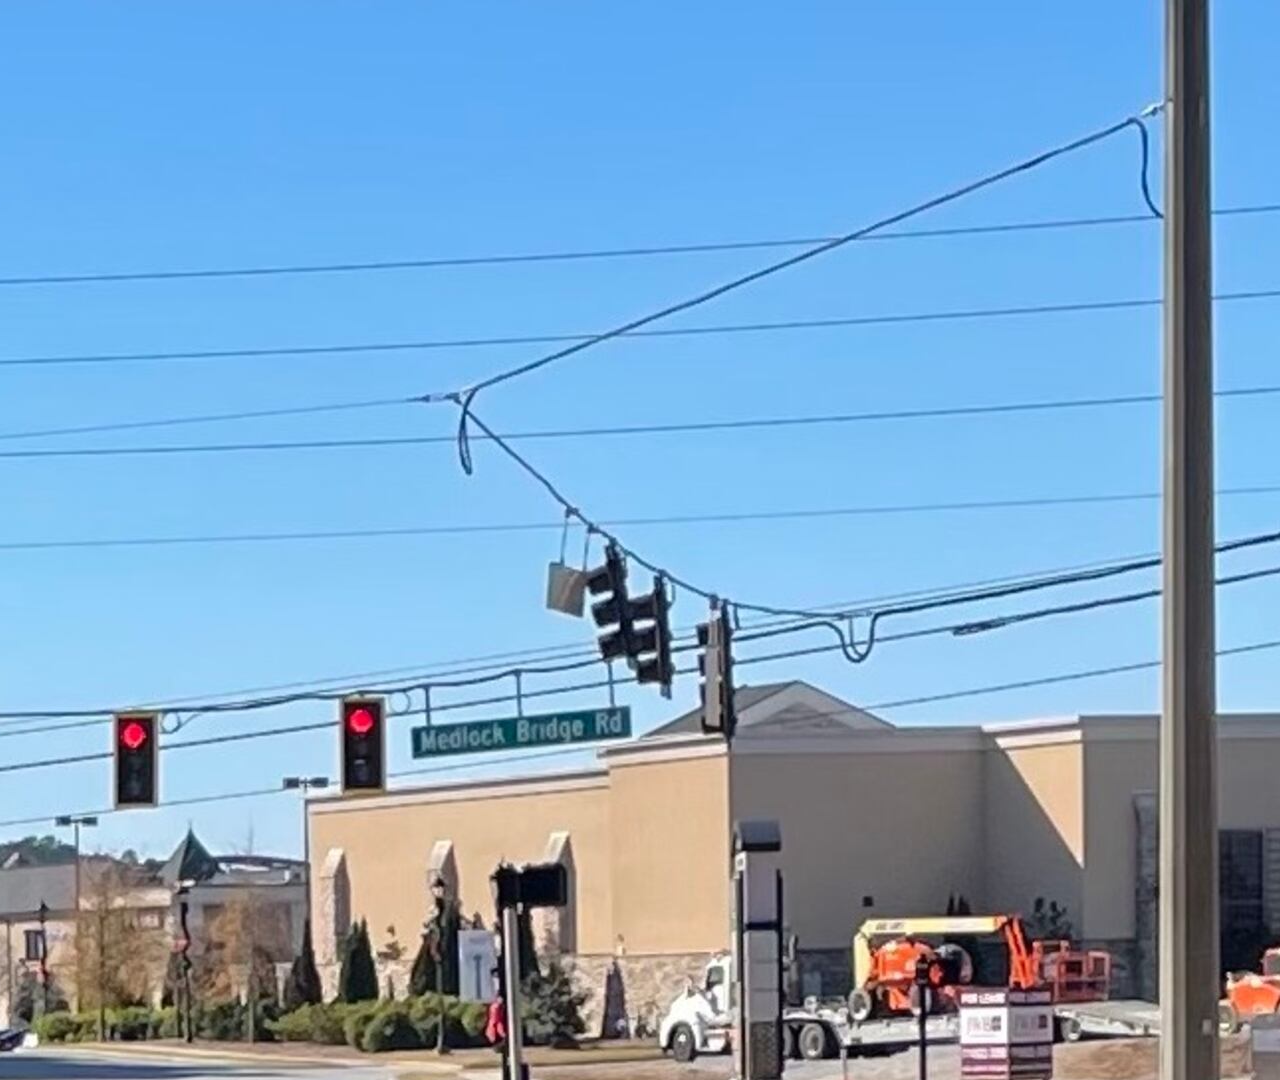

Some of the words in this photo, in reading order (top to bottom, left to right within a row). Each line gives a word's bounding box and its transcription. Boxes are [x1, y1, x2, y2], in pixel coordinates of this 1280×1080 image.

[421, 726, 505, 752] Medlock
[516, 718, 584, 741] Bridge
[595, 712, 622, 734] Rd
